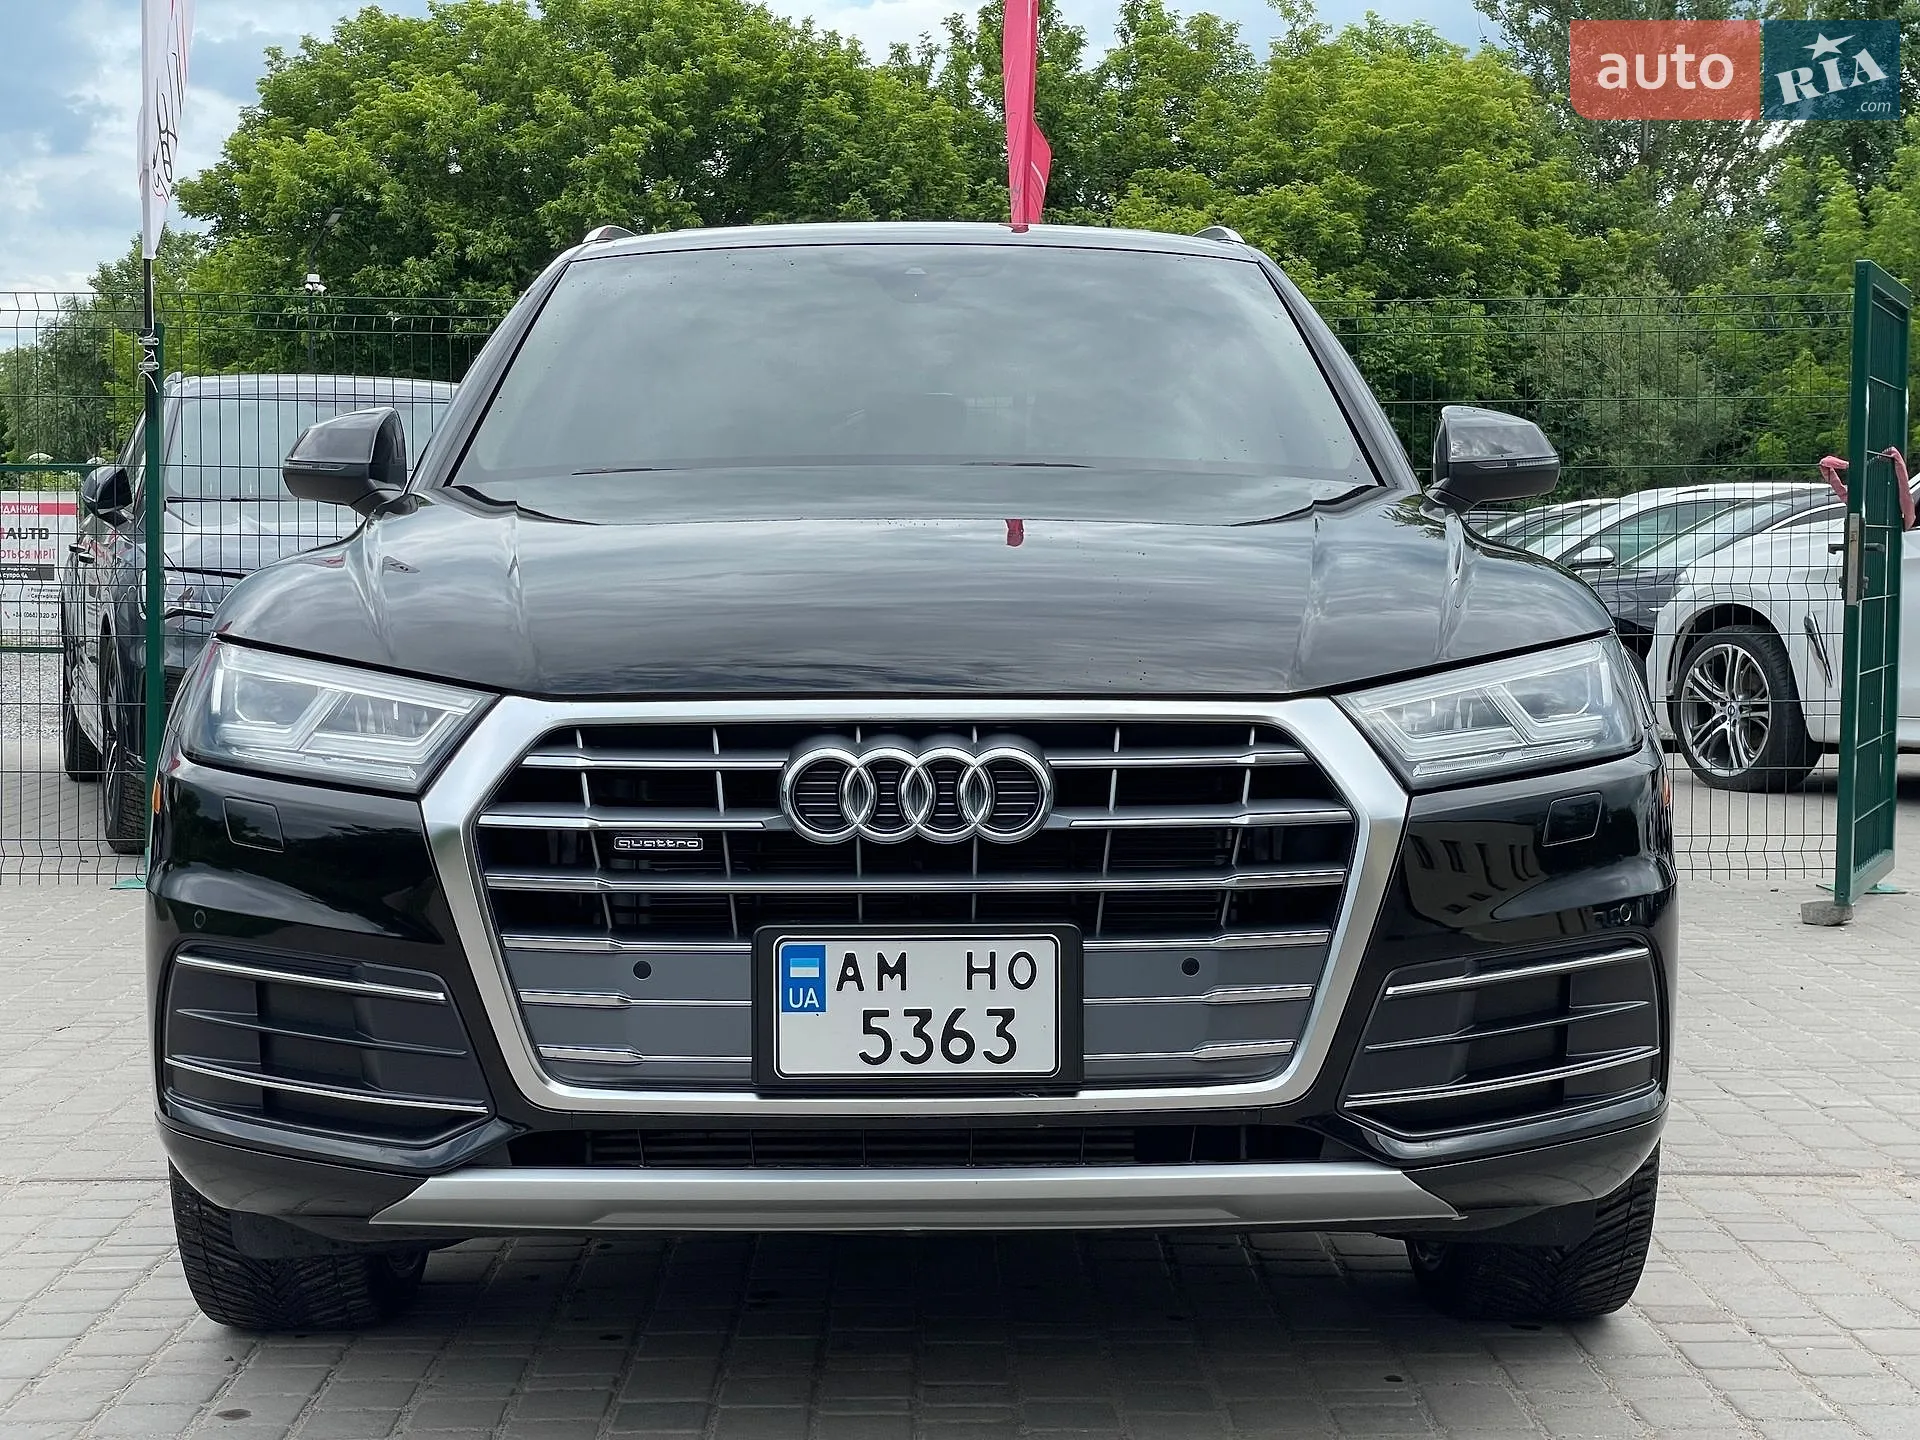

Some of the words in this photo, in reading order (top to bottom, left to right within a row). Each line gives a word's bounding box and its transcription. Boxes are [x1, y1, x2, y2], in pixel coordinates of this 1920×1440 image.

[0, 505, 38, 514] ДАНЧИК
[618, 839, 699, 849] quattro
[836, 952, 907, 991] AM
[966, 951, 1037, 990] HO
[789, 988, 819, 1008] UA
[858, 1008, 1017, 1066] 5363
